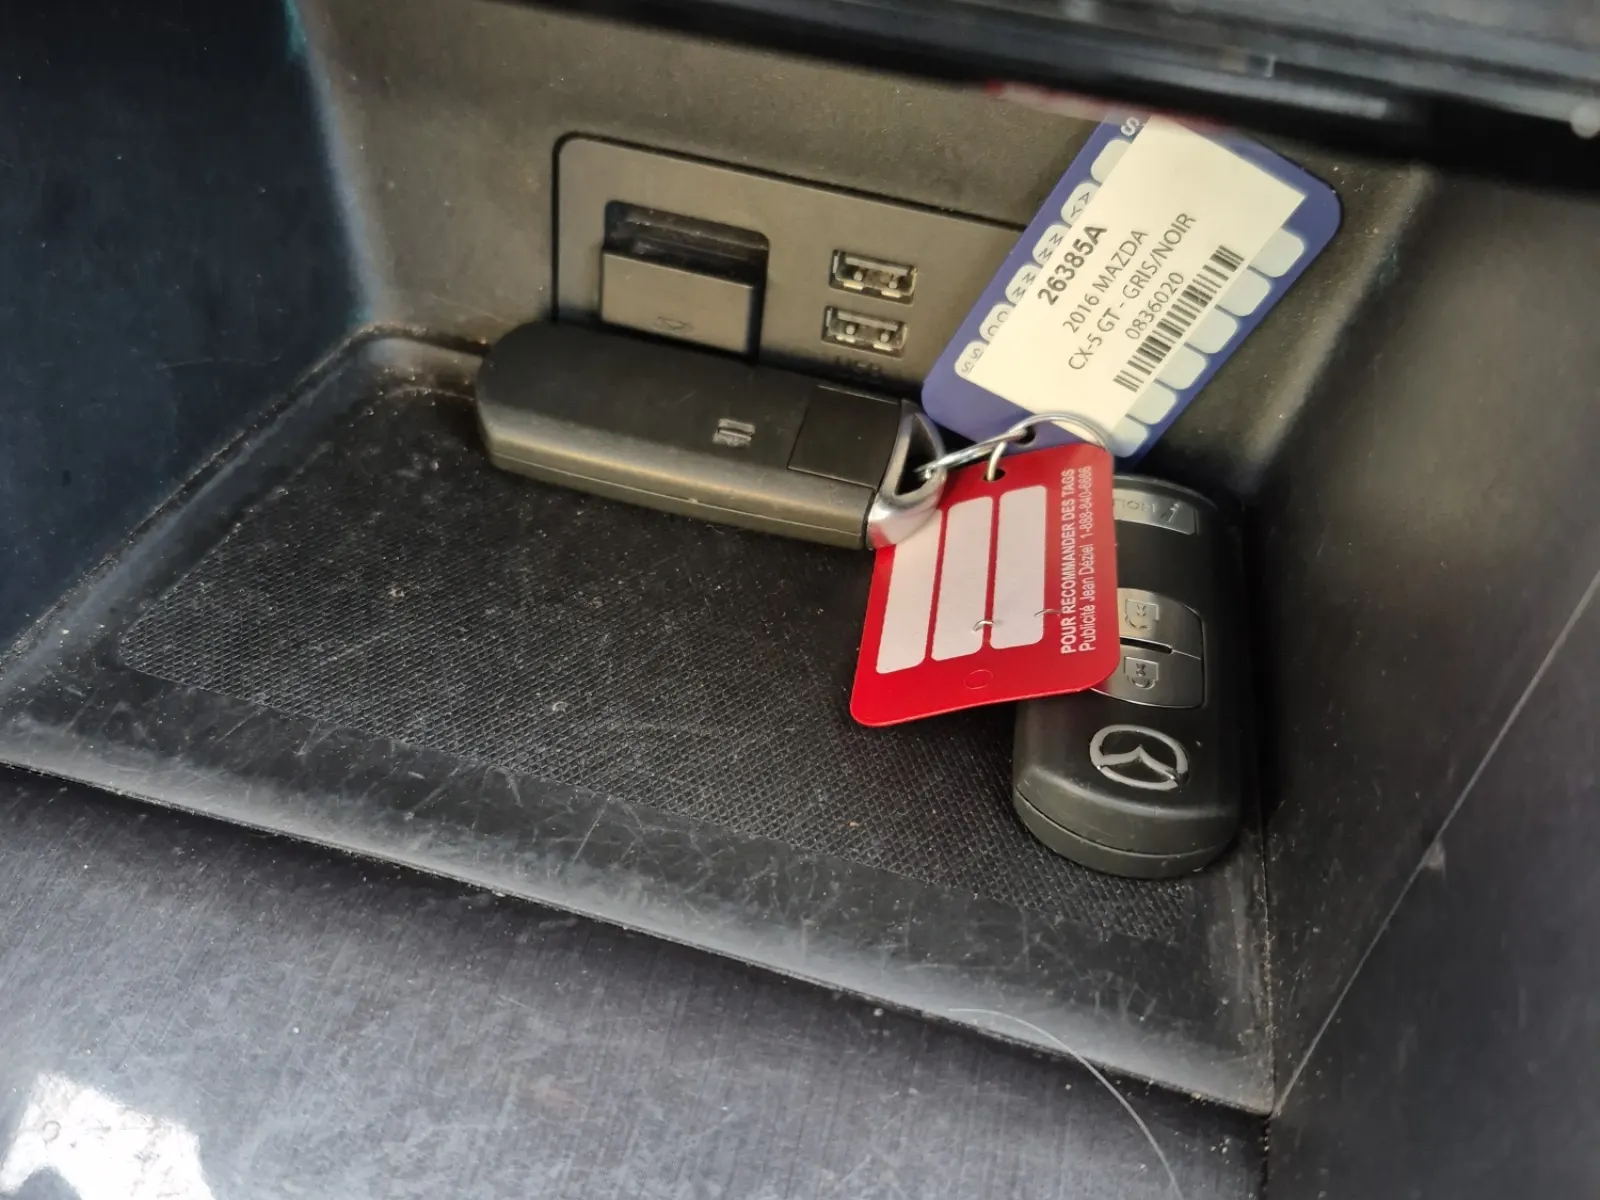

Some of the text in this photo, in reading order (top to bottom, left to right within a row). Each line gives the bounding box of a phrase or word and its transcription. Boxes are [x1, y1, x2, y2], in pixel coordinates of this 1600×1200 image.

[1037, 224, 1108, 306] 26385A
[1062, 228, 1149, 333] 2016 MAZDA
[1067, 332, 1103, 370] CX-5
[1096, 307, 1121, 333] GT
[1122, 212, 1197, 300] GRIS/NOIR
[1124, 271, 1185, 341] 0836020
[1060, 468, 1077, 655] POUR RECOMMANDER DES TAGS
[1079, 576, 1096, 602] Jean
[1078, 604, 1097, 652] Publicité
